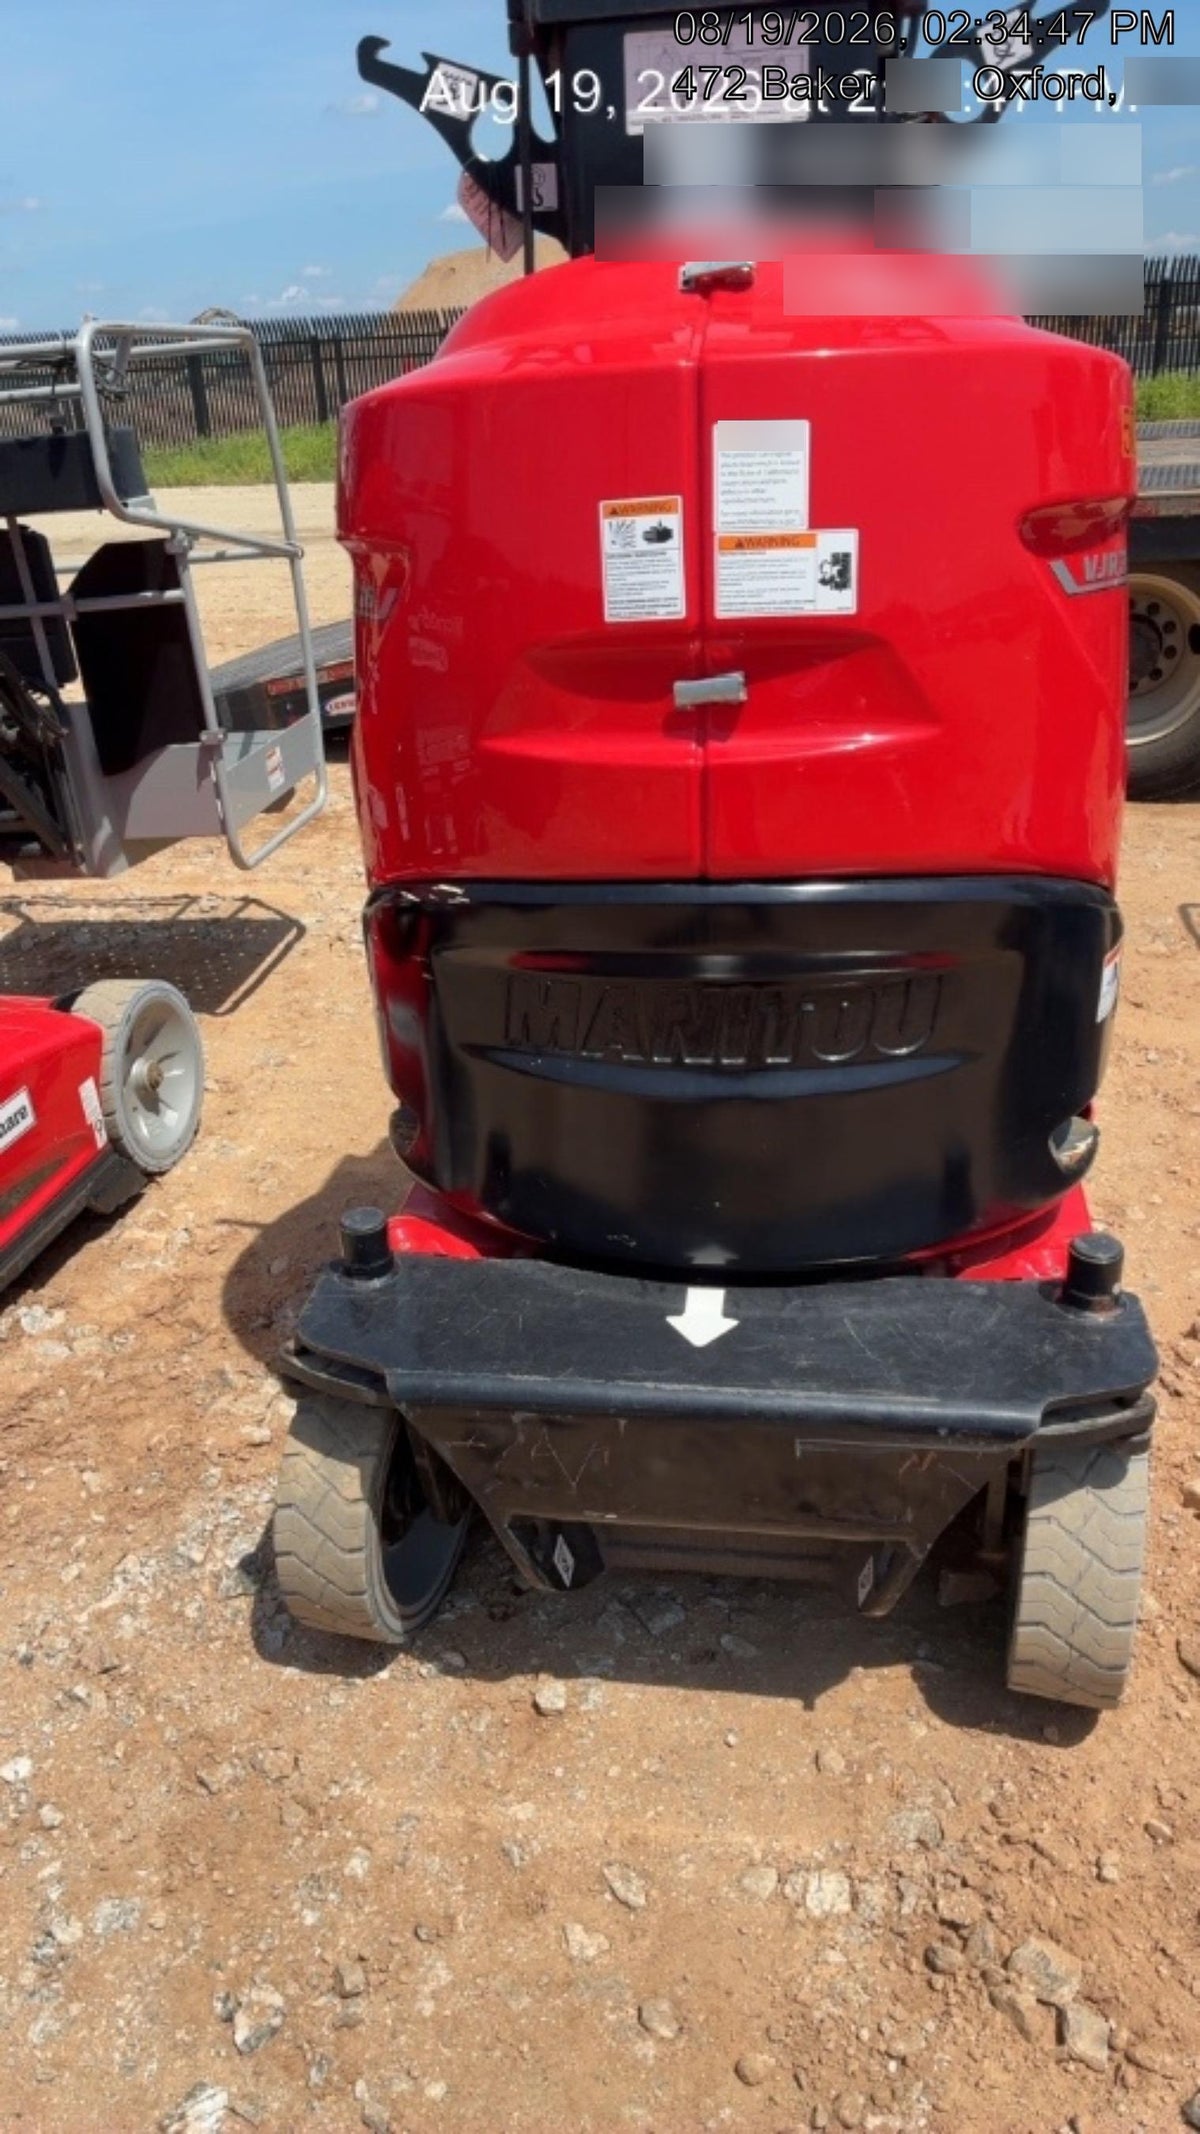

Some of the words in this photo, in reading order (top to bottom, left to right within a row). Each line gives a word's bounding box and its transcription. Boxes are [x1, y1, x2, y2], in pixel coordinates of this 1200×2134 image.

[618, 502, 673, 515] WARNING
[744, 536, 800, 549] WARNING
[503, 974, 944, 1065] MANITOU
